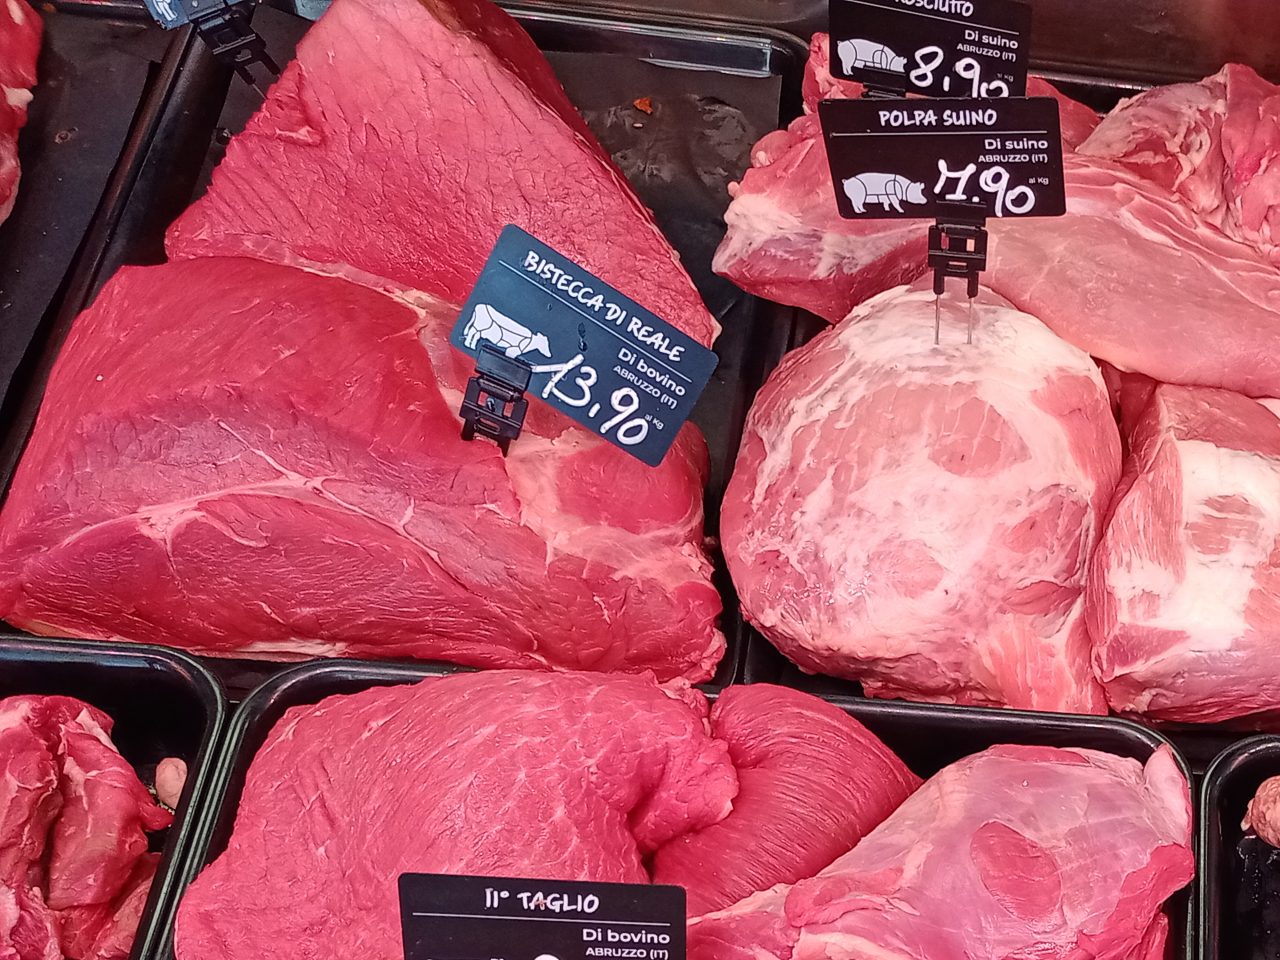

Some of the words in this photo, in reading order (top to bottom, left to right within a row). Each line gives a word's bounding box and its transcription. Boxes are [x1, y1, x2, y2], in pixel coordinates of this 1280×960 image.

[964, 29, 979, 41] Di
[982, 35, 1019, 49] suino
[956, 43, 1000, 58] ABRUZZO
[1002, 51, 1017, 62] (IT)
[878, 110, 938, 127] POLPA
[942, 108, 997, 126] SUINO
[984, 138, 1002, 150] Di
[1005, 137, 1049, 150] suino
[978, 154, 1030, 163] ABRUZZO
[1031, 154, 1048, 164] (IT)
[523, 250, 604, 312] BISTECCA
[605, 302, 627, 326] DI
[627, 317, 686, 363] REALE
[618, 347, 637, 367] Di
[637, 360, 686, 398] bovino
[612, 365, 661, 399] ABRUZZO
[660, 393, 679, 410] (IT)
[652, 417, 665, 431] Kg
[517, 891, 600, 913] TAGLIO
[582, 928, 604, 943] Di
[607, 929, 671, 945] bovino
[585, 947, 647, 959] ABRUZZO
[649, 948, 669, 960] (IT)
